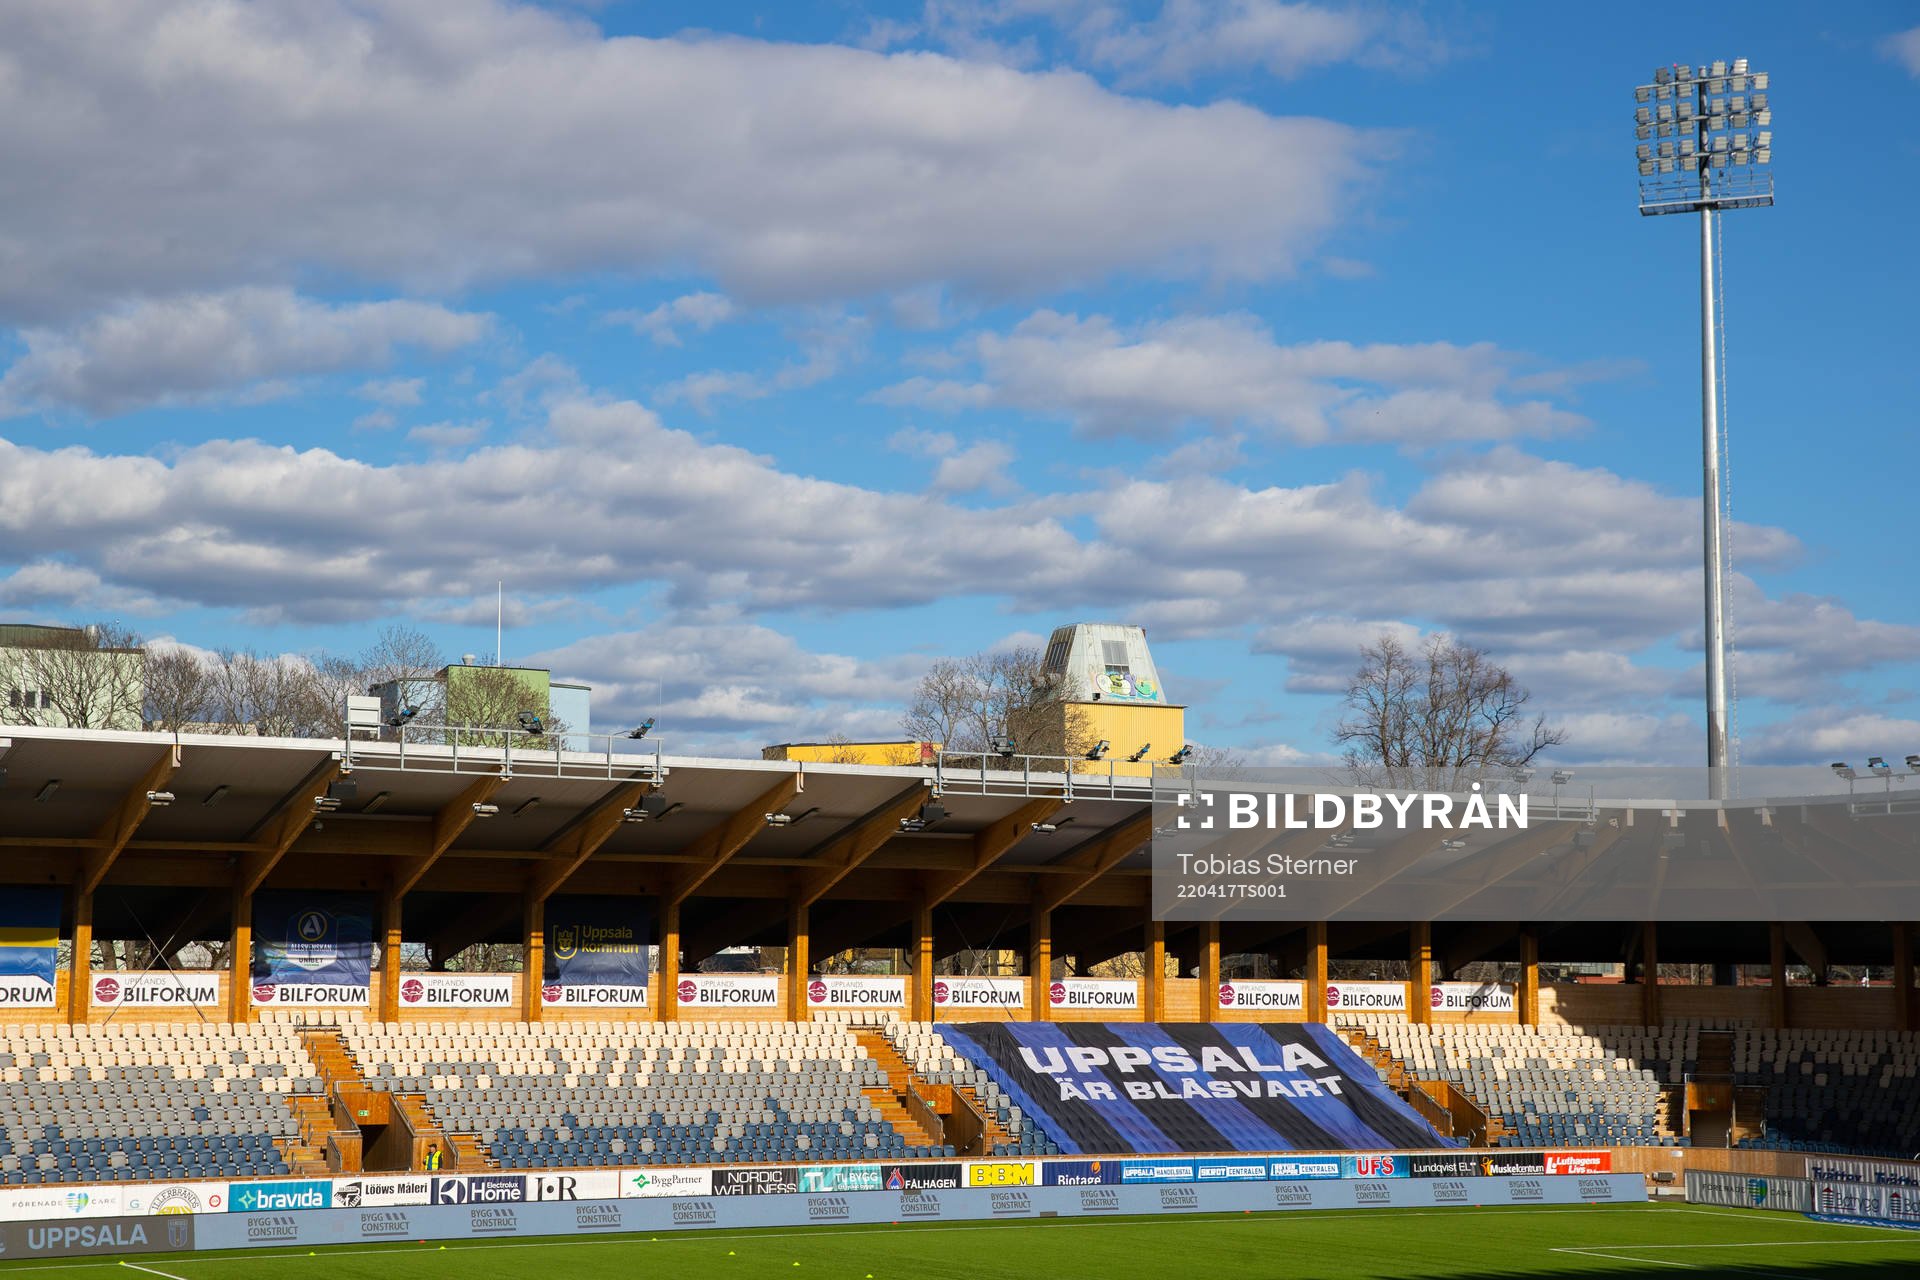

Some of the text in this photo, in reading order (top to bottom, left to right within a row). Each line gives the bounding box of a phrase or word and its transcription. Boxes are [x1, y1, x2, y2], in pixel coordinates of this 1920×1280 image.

[582, 925, 633, 940] Uppsala
[582, 940, 639, 954] kommun
[124, 978, 166, 986] UPPLANDS
[701, 980, 734, 988] UPPLANDS
[124, 988, 215, 1002] BILFORUM
[280, 988, 366, 1002] BILFORUM
[427, 988, 509, 1002] BILFORUM
[566, 988, 644, 1003] BILFORUM
[701, 989, 775, 1002] BILFORUM
[831, 990, 902, 1003] BILFORUM
[952, 990, 1021, 1004] BILFORUM
[1069, 992, 1135, 1004] BILFORUM
[1238, 994, 1300, 1006] BILFORUM
[1342, 994, 1403, 1006] BILFORUM
[1446, 996, 1511, 1008] BILFORUM
[1018, 1043, 1328, 1073] UPPSALA
[1055, 1075, 1343, 1101] ÄR BLÅSVART
[1356, 1157, 1394, 1176] UFS
[1556, 1157, 1600, 1166] Luthagens
[1228, 1167, 1263, 1175] CENTRALEN
[1414, 1163, 1457, 1173] Lundqvist
[1568, 1165, 1586, 1174] Livs
[728, 1171, 783, 1183] NORDIC
[850, 1172, 878, 1182] BYGG
[970, 1163, 1034, 1186] BBM
[487, 1181, 518, 1189] Electrolux
[651, 1175, 702, 1188] ByggPartner
[905, 1178, 957, 1189] FÅLHAGEN
[1432, 1182, 1449, 1190] BYGG
[365, 1182, 428, 1195] Lööws Måleri
[471, 1182, 521, 1201] Home
[1160, 1188, 1178, 1196] BYGG
[257, 1188, 323, 1209] bravida
[1080, 1190, 1098, 1198] BYGG
[1434, 1190, 1468, 1198] CONSTRUCT
[992, 1200, 1031, 1209] CONSTRUCT
[1082, 1198, 1119, 1206] CONSTRUCT
[1162, 1196, 1198, 1204] CONSTRUCT
[576, 1206, 598, 1214] BYGG
[672, 1202, 692, 1210] BYGG
[809, 1206, 849, 1215] CONSTRUCT
[901, 1203, 940, 1212] CONSTRUCT
[361, 1213, 384, 1222] BYGG
[471, 1209, 492, 1218] BYGG
[674, 1211, 716, 1220] CONSTRUCT
[248, 1217, 271, 1226] BYGG
[472, 1218, 517, 1228] CONSTRUCT
[577, 1214, 622, 1224] CONSTRUCT
[248, 1226, 298, 1237] CONSTRUCT
[362, 1222, 410, 1232] CONSTRUCT
[28, 1224, 148, 1249] UPPSALA
